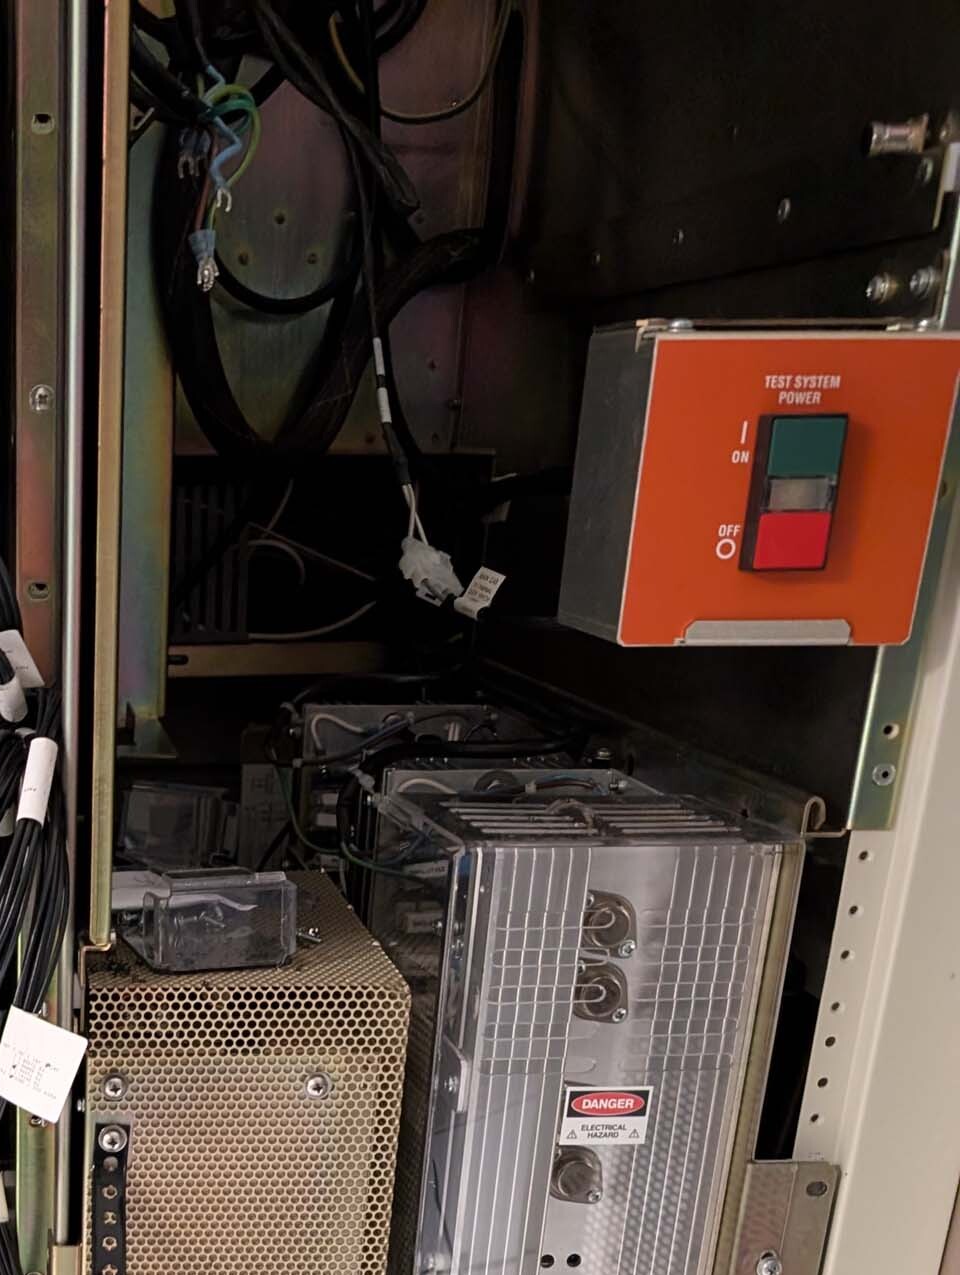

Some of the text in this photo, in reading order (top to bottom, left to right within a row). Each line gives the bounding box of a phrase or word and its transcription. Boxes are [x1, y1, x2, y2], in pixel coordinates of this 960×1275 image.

[765, 376, 841, 389] TEST SYSTEM
[779, 391, 821, 404] POWER
[732, 451, 749, 463] ON
[719, 525, 740, 537] OFF
[582, 1098, 634, 1109] DANGER
[580, 1123, 628, 1131] ELECTRICAL
[587, 1131, 620, 1139] HAZARD
